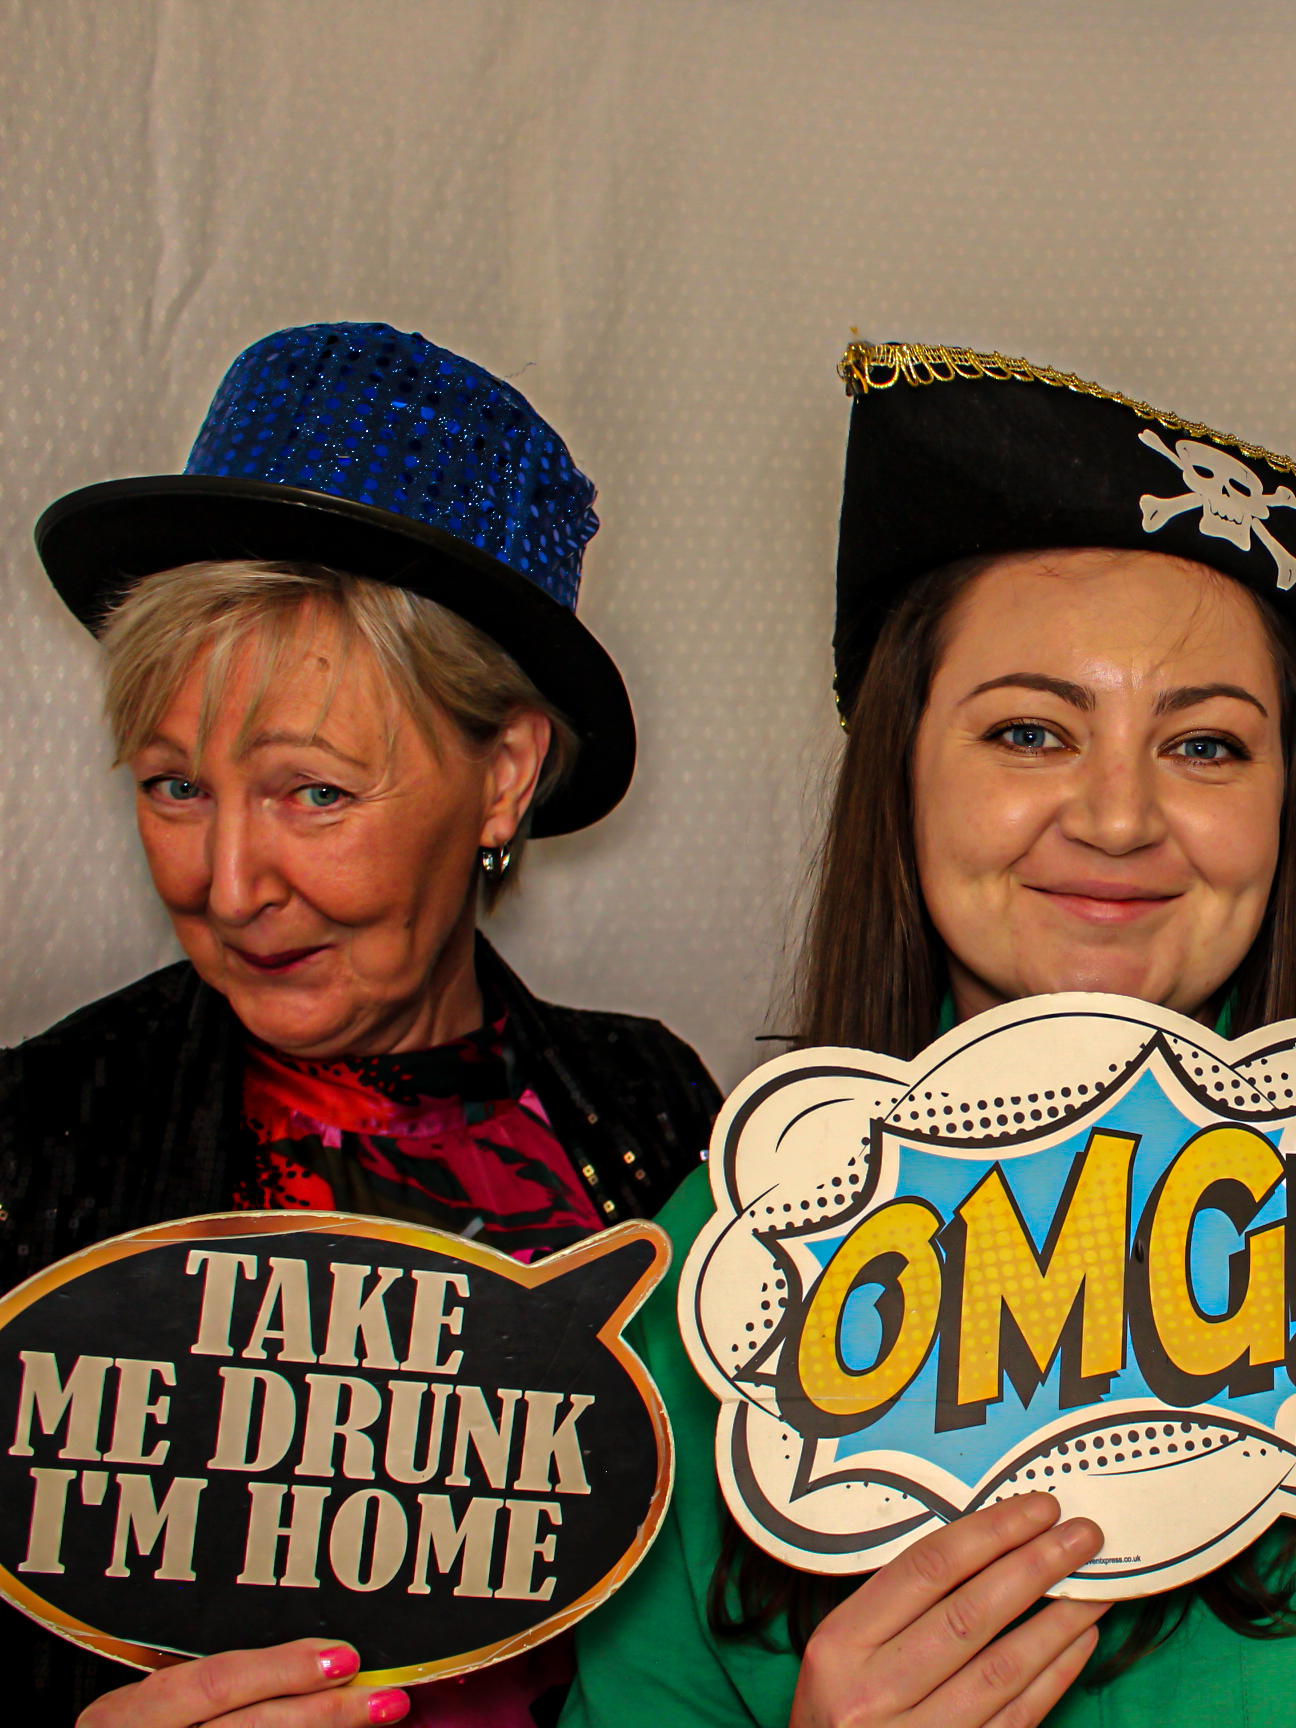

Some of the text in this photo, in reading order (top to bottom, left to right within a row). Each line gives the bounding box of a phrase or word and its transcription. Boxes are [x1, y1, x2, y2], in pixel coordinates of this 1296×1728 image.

[186, 1249, 471, 1374] TAKE
[9, 1350, 595, 1494] ME DRUNK
[18, 1467, 563, 1601] I'M HOME
